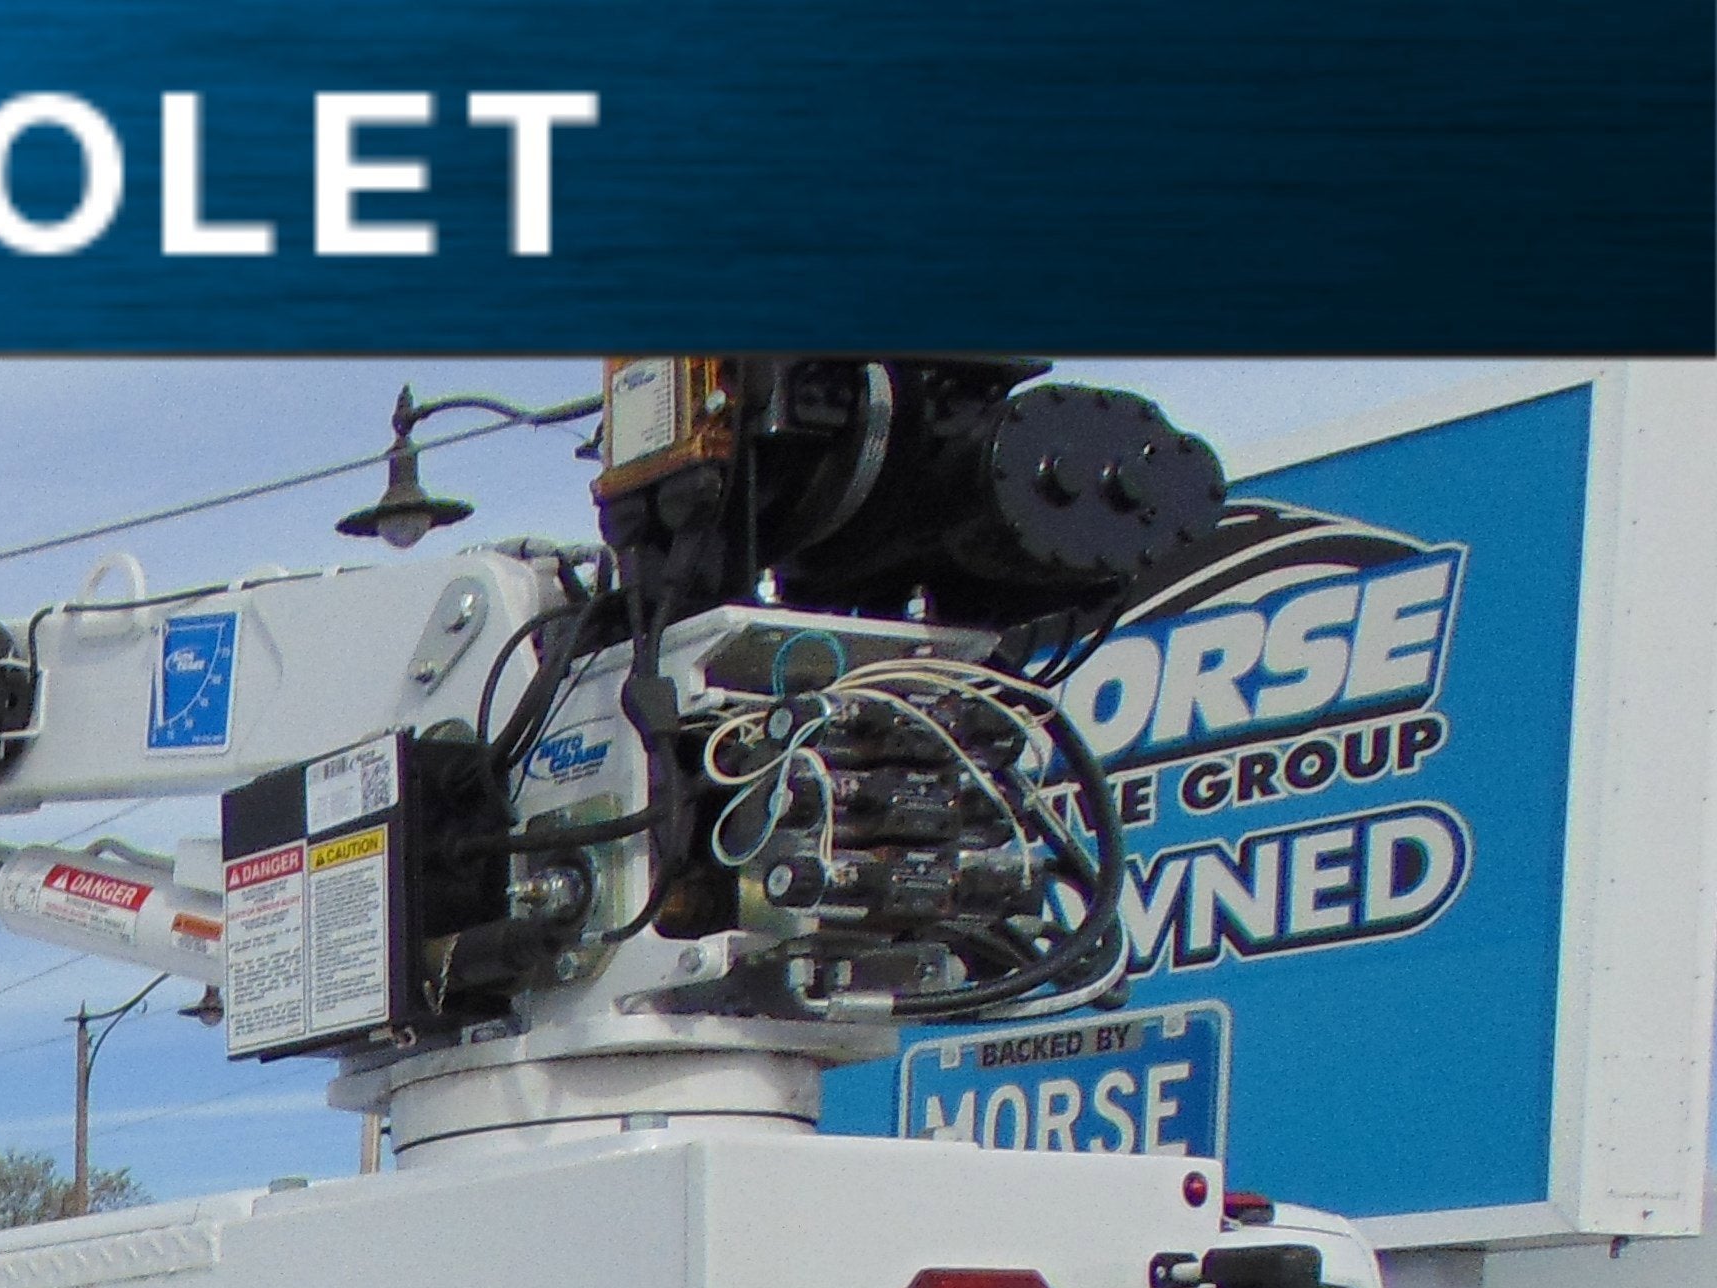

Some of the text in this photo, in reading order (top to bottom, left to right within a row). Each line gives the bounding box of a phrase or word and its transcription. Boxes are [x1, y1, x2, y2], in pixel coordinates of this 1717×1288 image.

[1049, 560, 1454, 757] ORSE
[1180, 716, 1443, 811] GROUP
[241, 850, 301, 882] DANGER
[327, 836, 380, 865] CAUTION
[69, 872, 139, 907] DANGER
[980, 1022, 1133, 1067] BACKED BY
